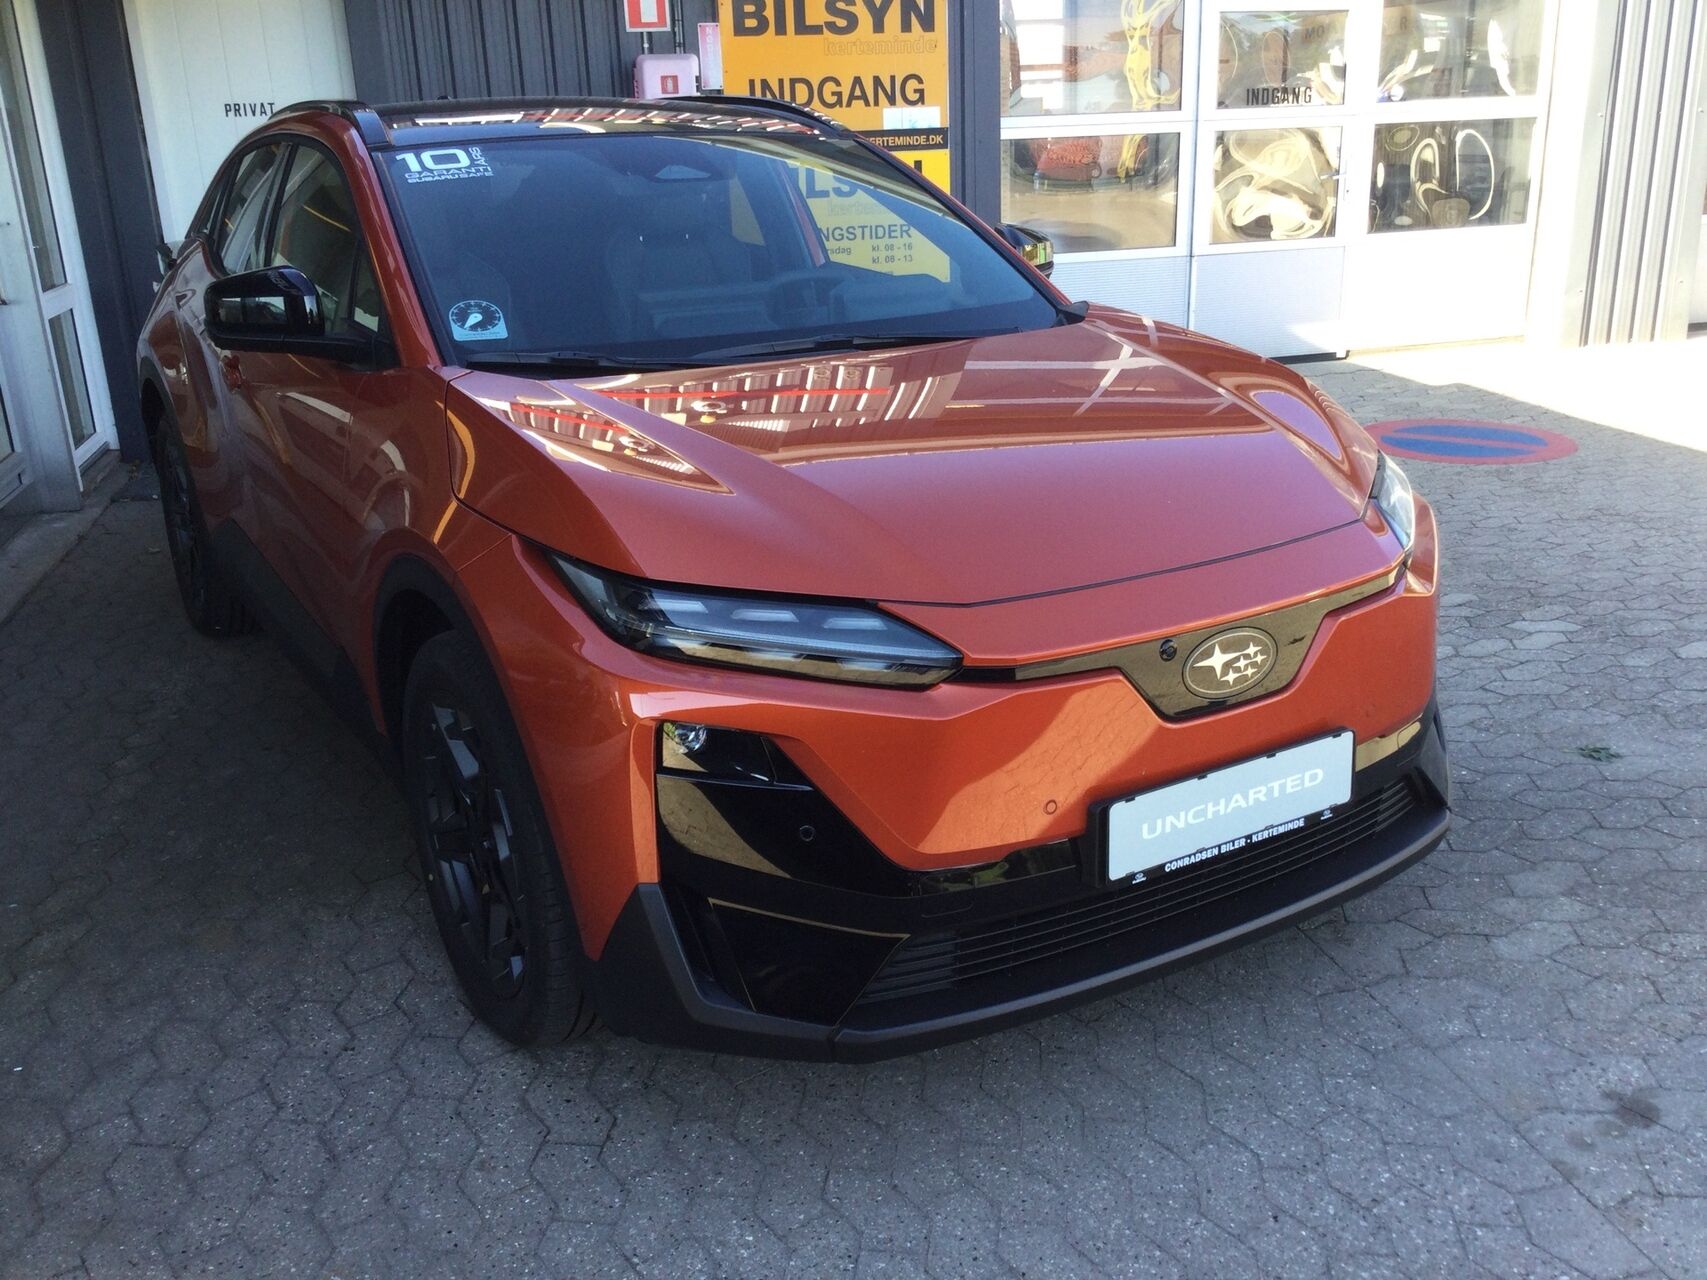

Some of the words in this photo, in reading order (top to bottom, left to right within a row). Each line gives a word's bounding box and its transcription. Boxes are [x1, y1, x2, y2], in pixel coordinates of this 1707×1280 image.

[733, 0, 935, 37] BILSYN
[748, 73, 925, 109] INDGANG
[1246, 86, 1312, 106] INDGANG
[224, 102, 275, 118] PRIVAT
[867, 134, 944, 148] ERTEMINDE.DK
[395, 149, 471, 172] 10
[818, 224, 912, 242] NGSTIDER
[1141, 768, 1324, 840] UNCHARTED
[1164, 846, 1219, 873] CONRADSEN
[1220, 838, 1246, 854] BILER
[1251, 817, 1305, 843] KERTEMINDE
